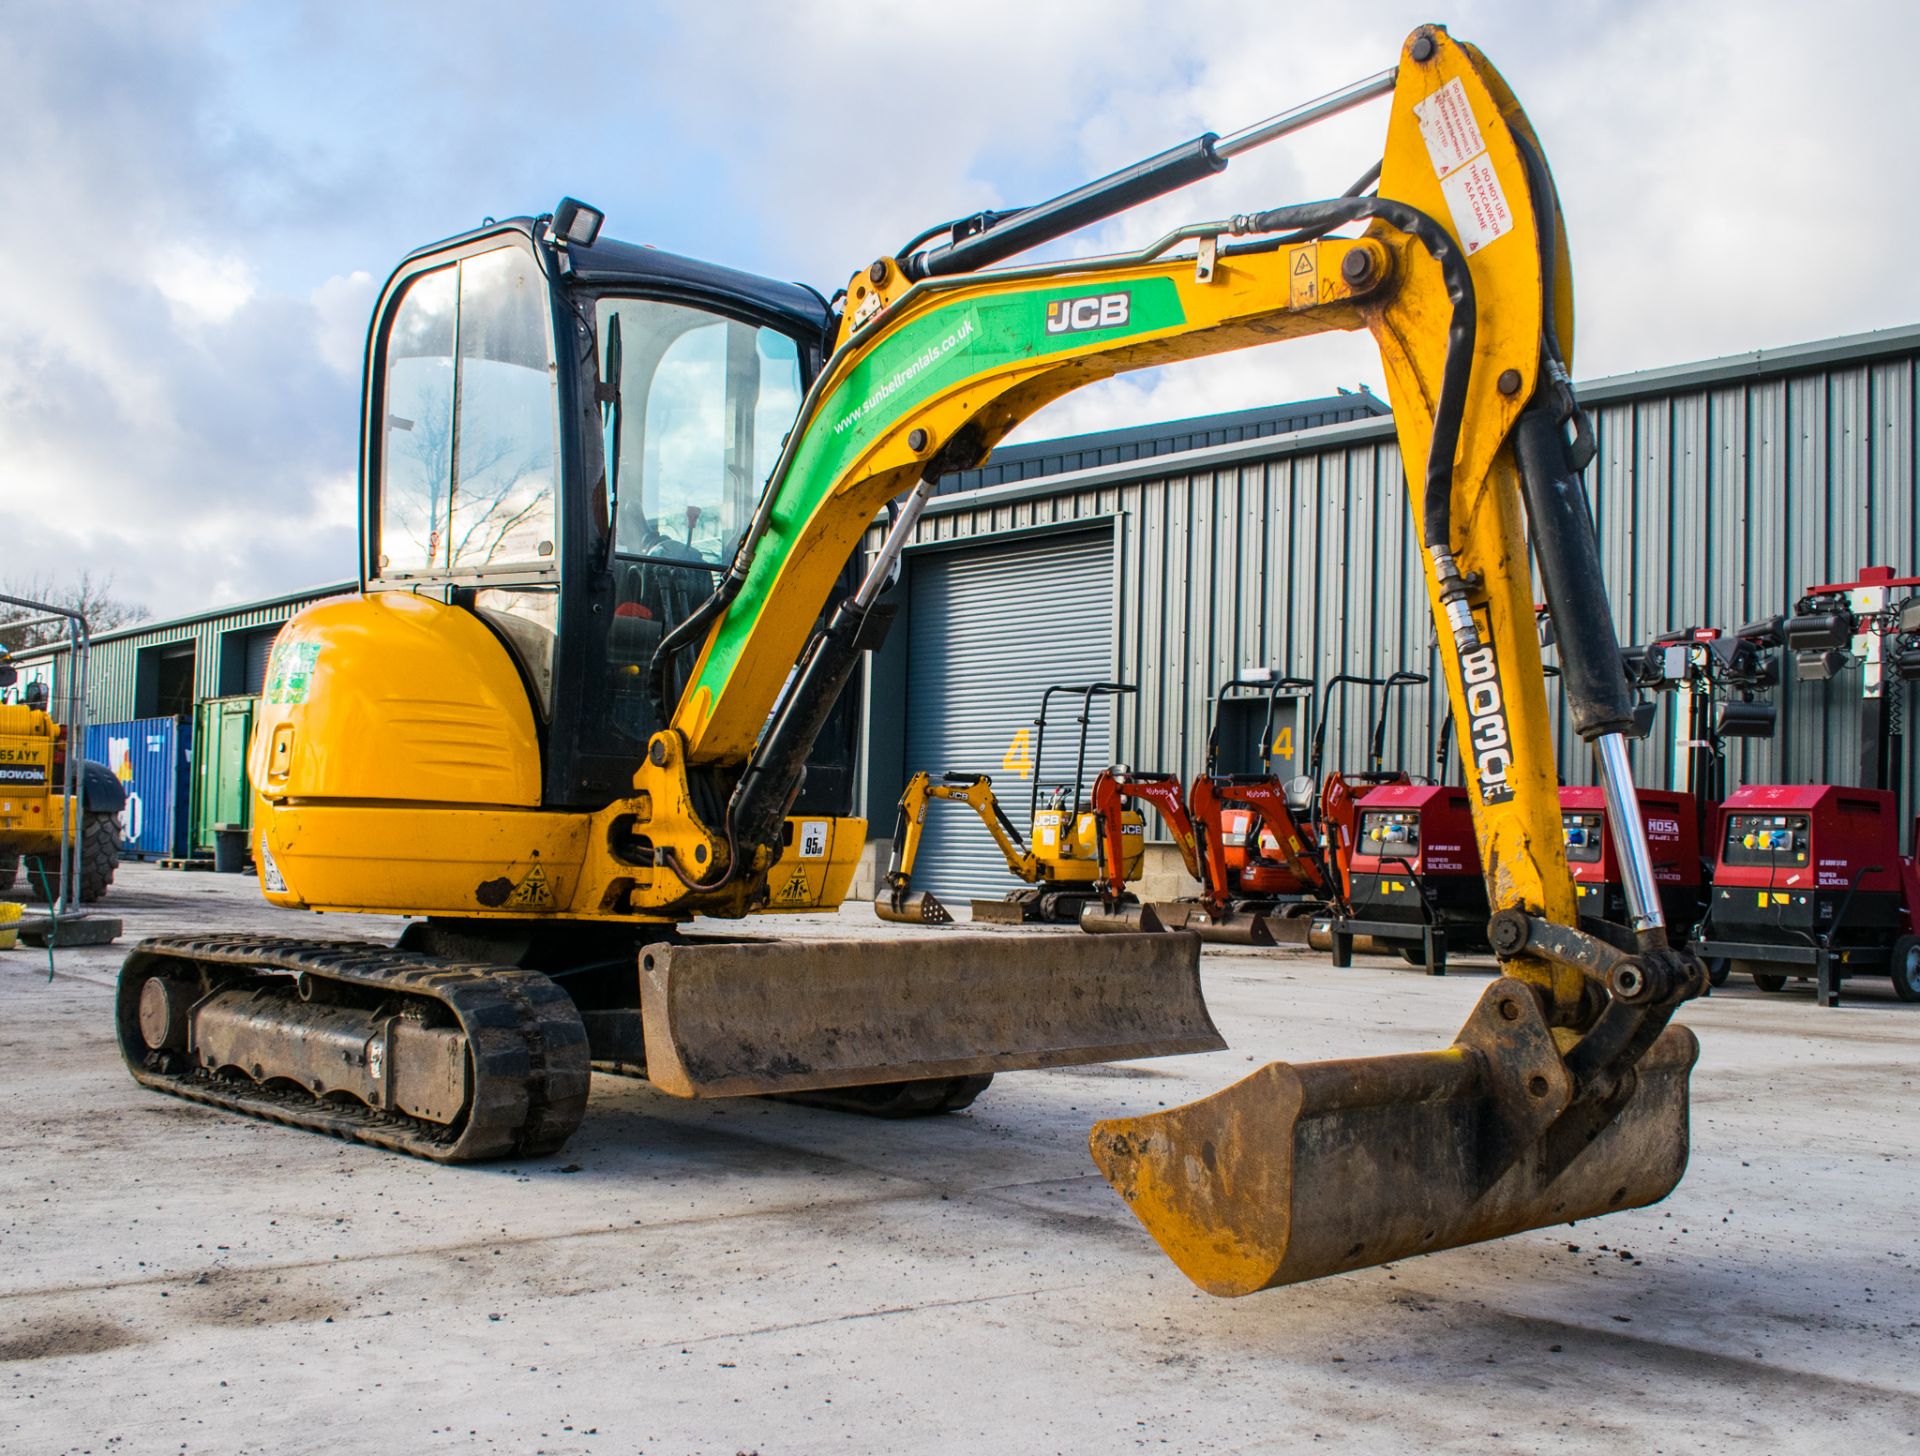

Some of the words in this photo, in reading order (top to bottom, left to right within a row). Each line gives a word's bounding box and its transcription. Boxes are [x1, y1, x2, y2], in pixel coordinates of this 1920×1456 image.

[1453, 83, 1460, 93] DO
[1457, 93, 1465, 107] NOT
[1464, 182, 1473, 194] AS
[1472, 201, 1487, 231] CRANE
[1469, 163, 1480, 185] THIS
[1477, 185, 1500, 236] EXCAVATOR
[1482, 168, 1491, 182] DO
[1488, 183, 1499, 201] NOT
[1495, 203, 1505, 220] USE
[1047, 294, 1129, 332] JCB
[833, 320, 974, 434] www.sunbeltrentals.co.uk
[1462, 648, 1511, 784] 8030
[17, 750, 39, 760] AYY
[1002, 728, 1033, 779] 4
[1272, 726, 1294, 760] 4
[949, 791, 968, 800] JCB
[1035, 814, 1059, 826] JCB
[1120, 825, 1142, 835] JCB
[1648, 820, 1679, 833] MOSA
[1818, 878, 1849, 886] SILENCED
